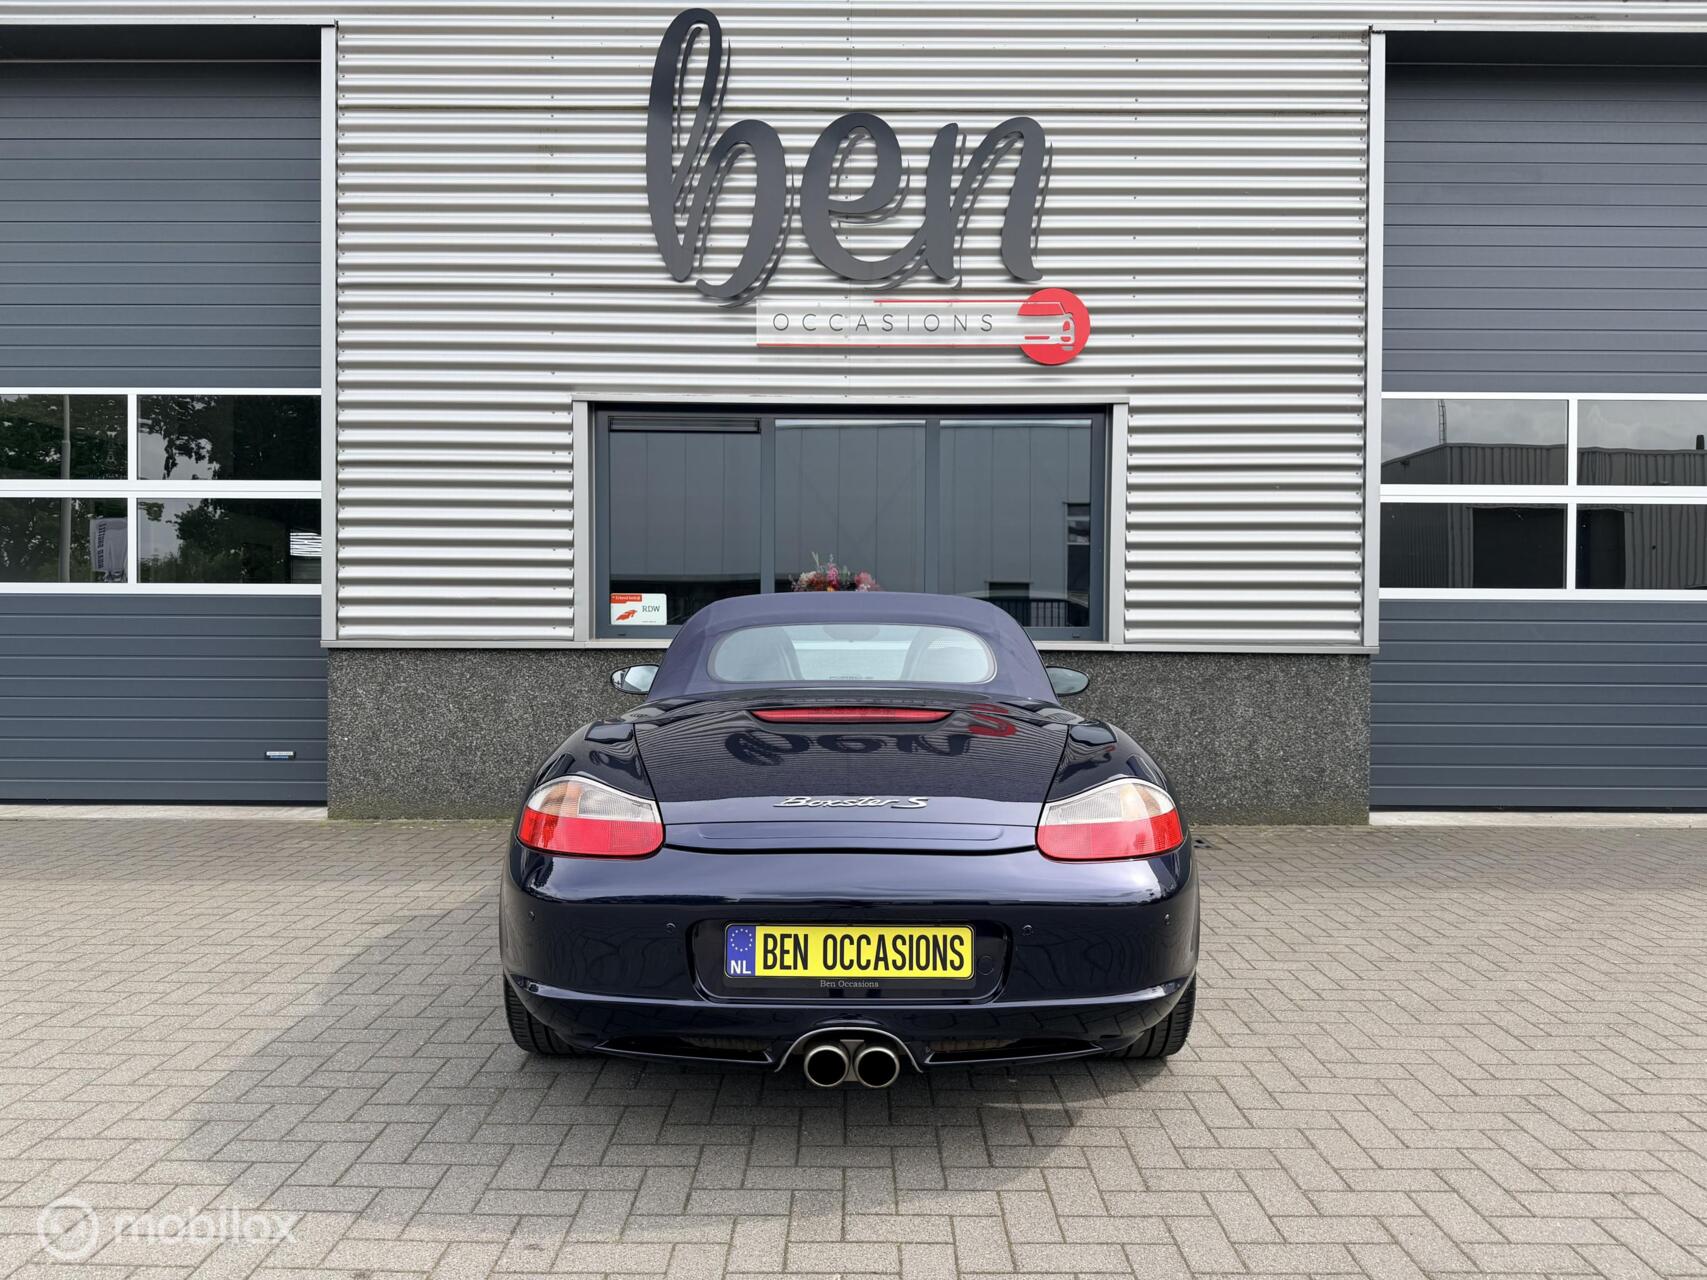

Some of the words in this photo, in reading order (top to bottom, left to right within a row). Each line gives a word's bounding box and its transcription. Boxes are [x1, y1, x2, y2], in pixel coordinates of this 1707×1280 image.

[646, 8, 1046, 299] ben
[773, 312, 994, 332] OCCASIONS
[642, 605, 660, 613] RDW
[773, 796, 898, 808] Boxster
[890, 796, 929, 809] S
[763, 933, 809, 971] BEN
[822, 933, 965, 971] OCCASIONS
[730, 960, 752, 975] NL
[820, 979, 836, 988] Ben
[838, 979, 879, 988] Occasions
